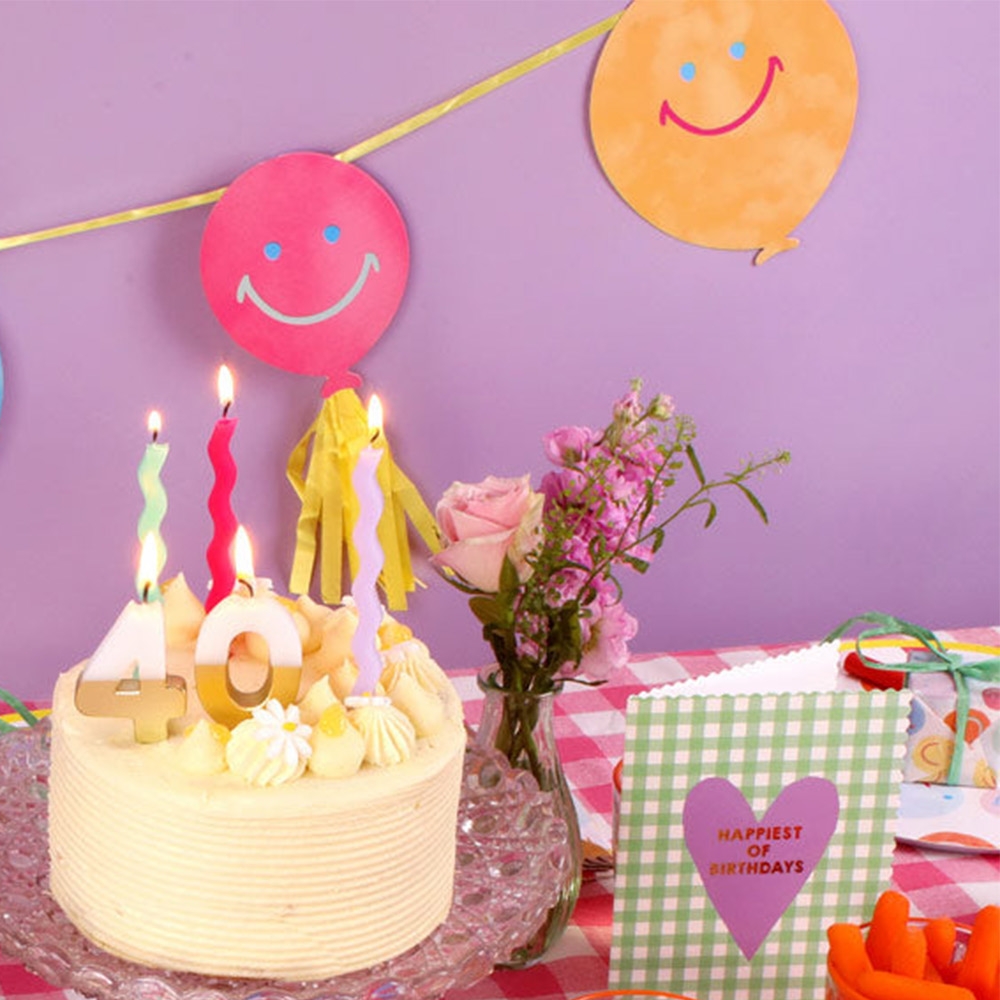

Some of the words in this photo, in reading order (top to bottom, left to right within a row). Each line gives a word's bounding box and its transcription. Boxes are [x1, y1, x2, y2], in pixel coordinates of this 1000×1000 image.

[74, 596, 302, 744] 40
[717, 825, 803, 842] HAPPIEST
[746, 844, 771, 858] OF
[708, 860, 804, 876] BIRTHDAYS
